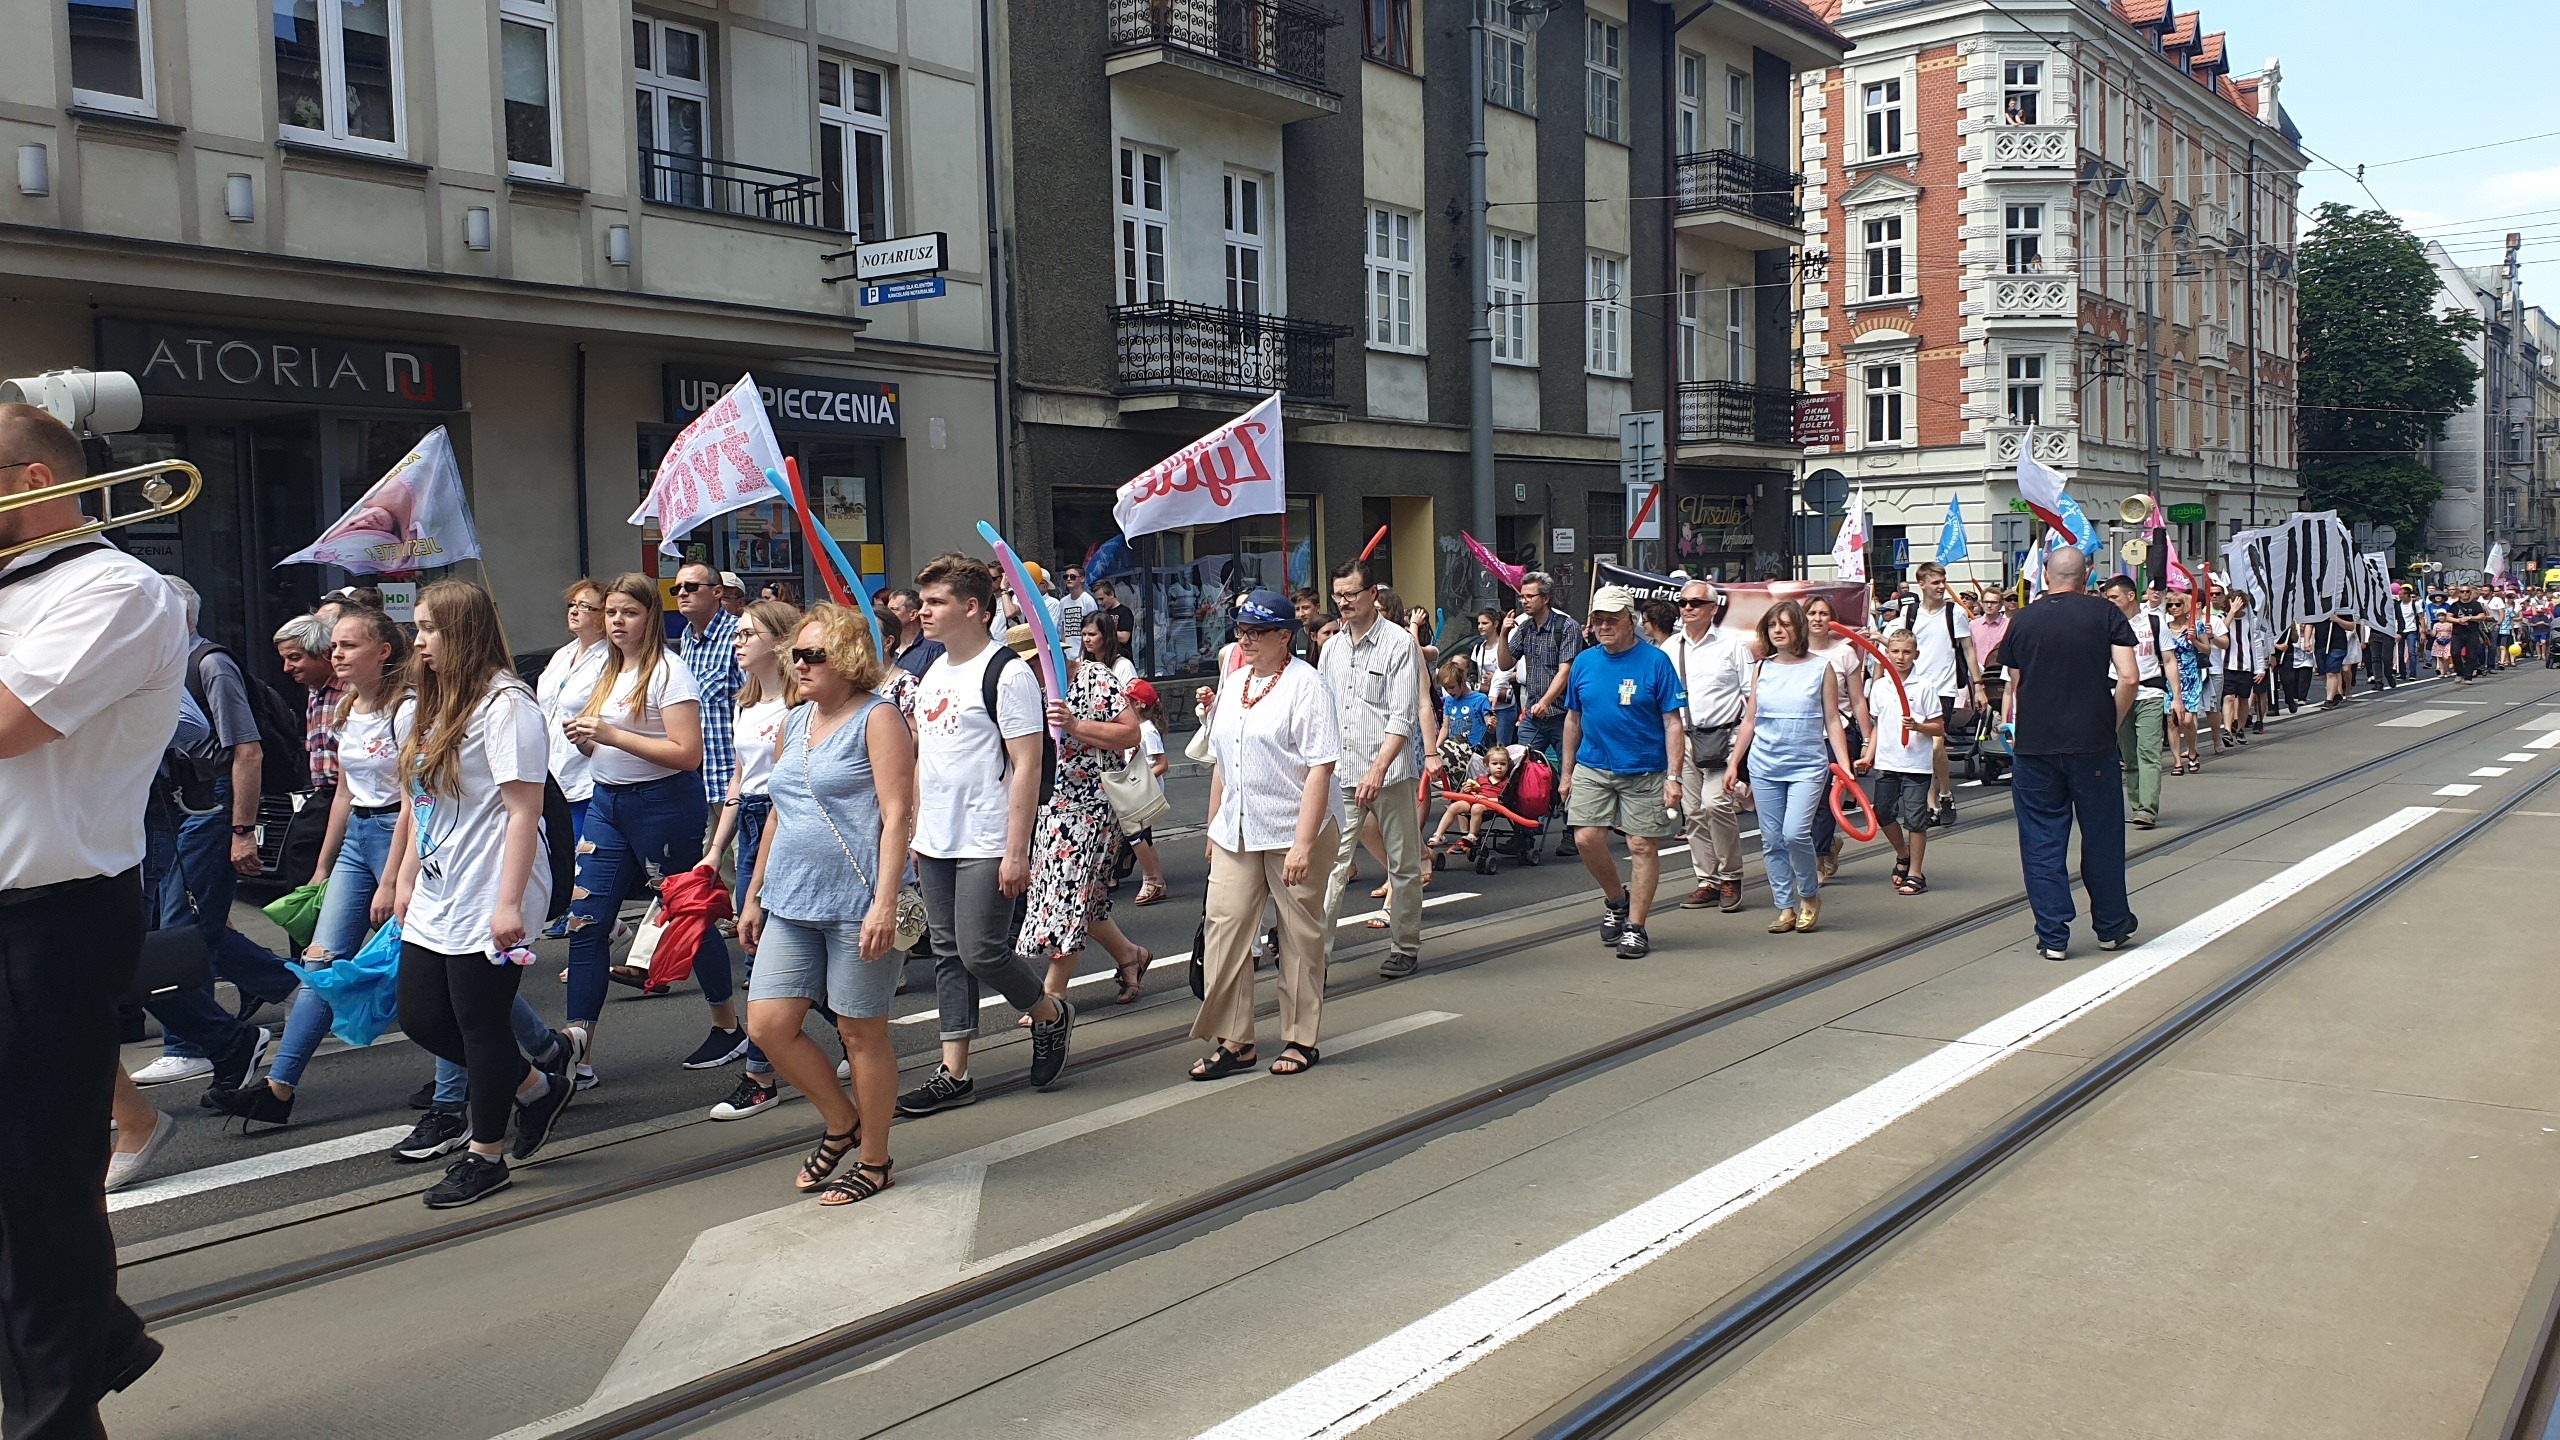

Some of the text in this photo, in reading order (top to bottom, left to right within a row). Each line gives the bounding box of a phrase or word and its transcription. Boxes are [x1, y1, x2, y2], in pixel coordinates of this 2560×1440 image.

[861, 246, 934, 268] NOTARIUSZ
[870, 289, 877, 301] P
[142, 338, 370, 392] ATORIA
[680, 379, 895, 425] UBPIECZENIA
[1805, 407, 1829, 415] OKNA
[1803, 414, 1831, 422] DRZWI
[1799, 421, 1834, 430] ROLETY
[1819, 434, 1829, 442] 50
[385, 593, 410, 603] HDI
